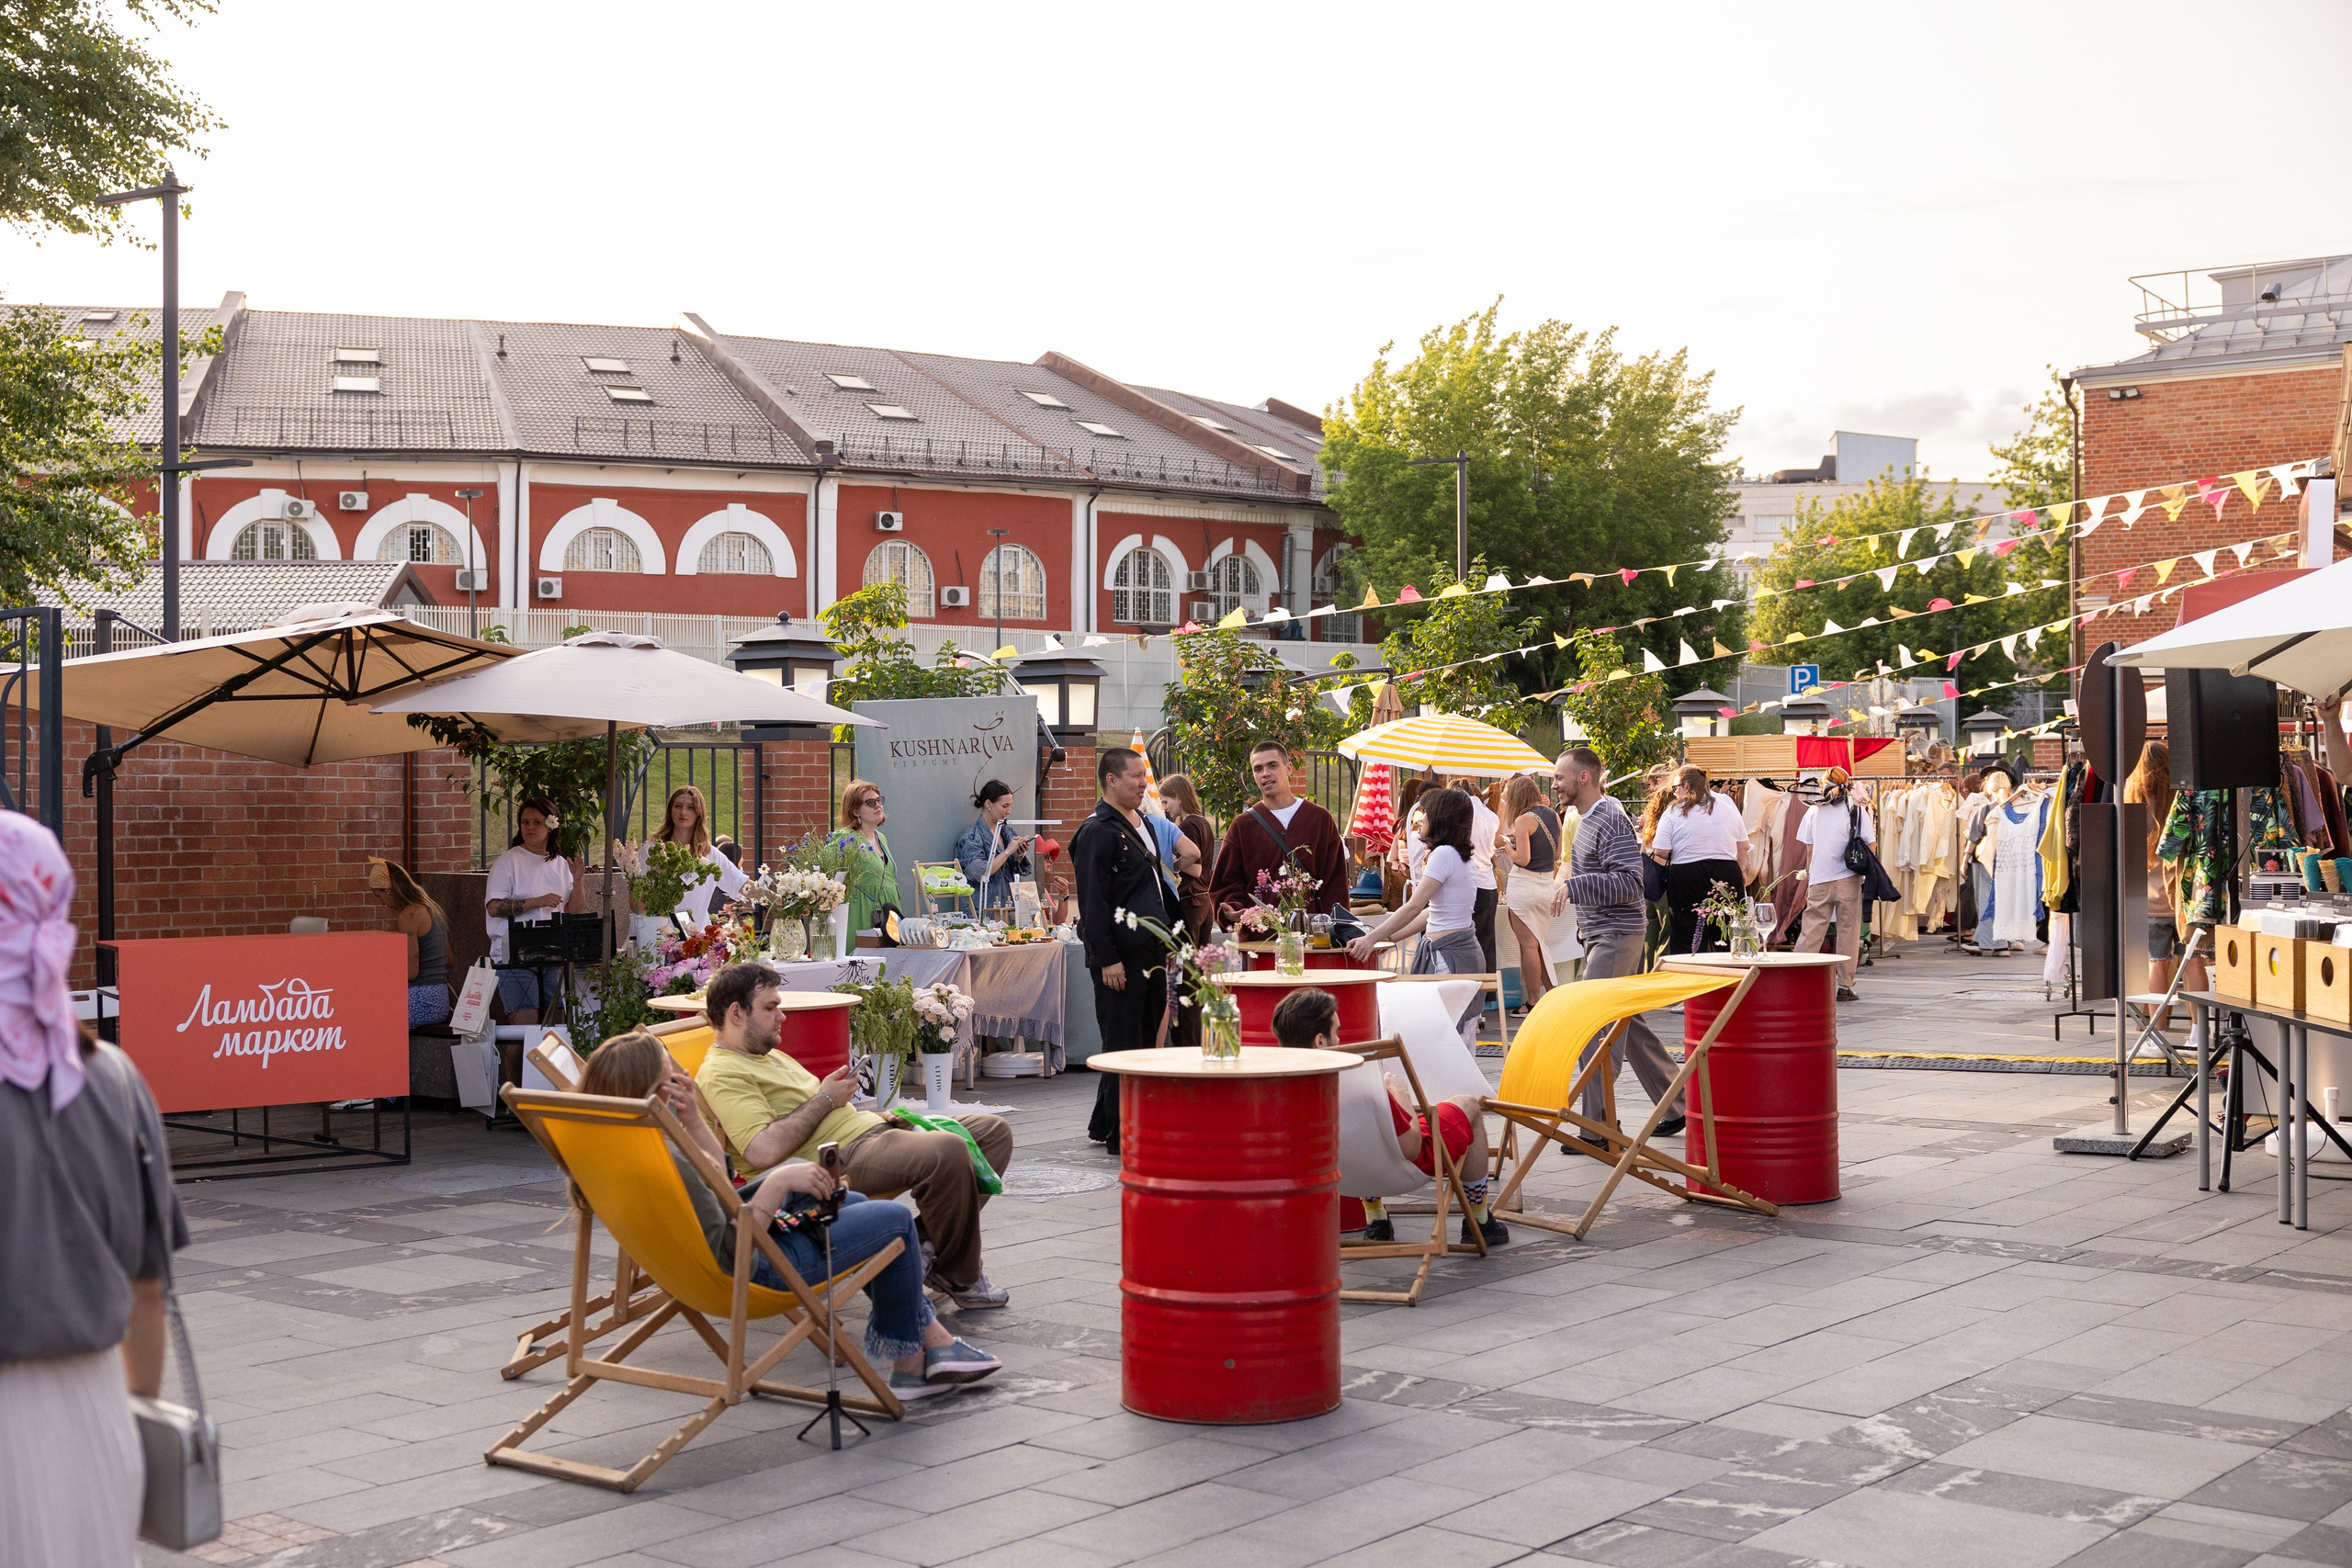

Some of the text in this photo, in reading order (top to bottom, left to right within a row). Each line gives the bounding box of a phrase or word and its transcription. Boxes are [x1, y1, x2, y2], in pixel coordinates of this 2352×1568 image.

[1794, 668, 1811, 692] P
[893, 758, 957, 768] PERFUME
[176, 977, 334, 1032] Ламбада
[212, 1026, 346, 1069] маркет
